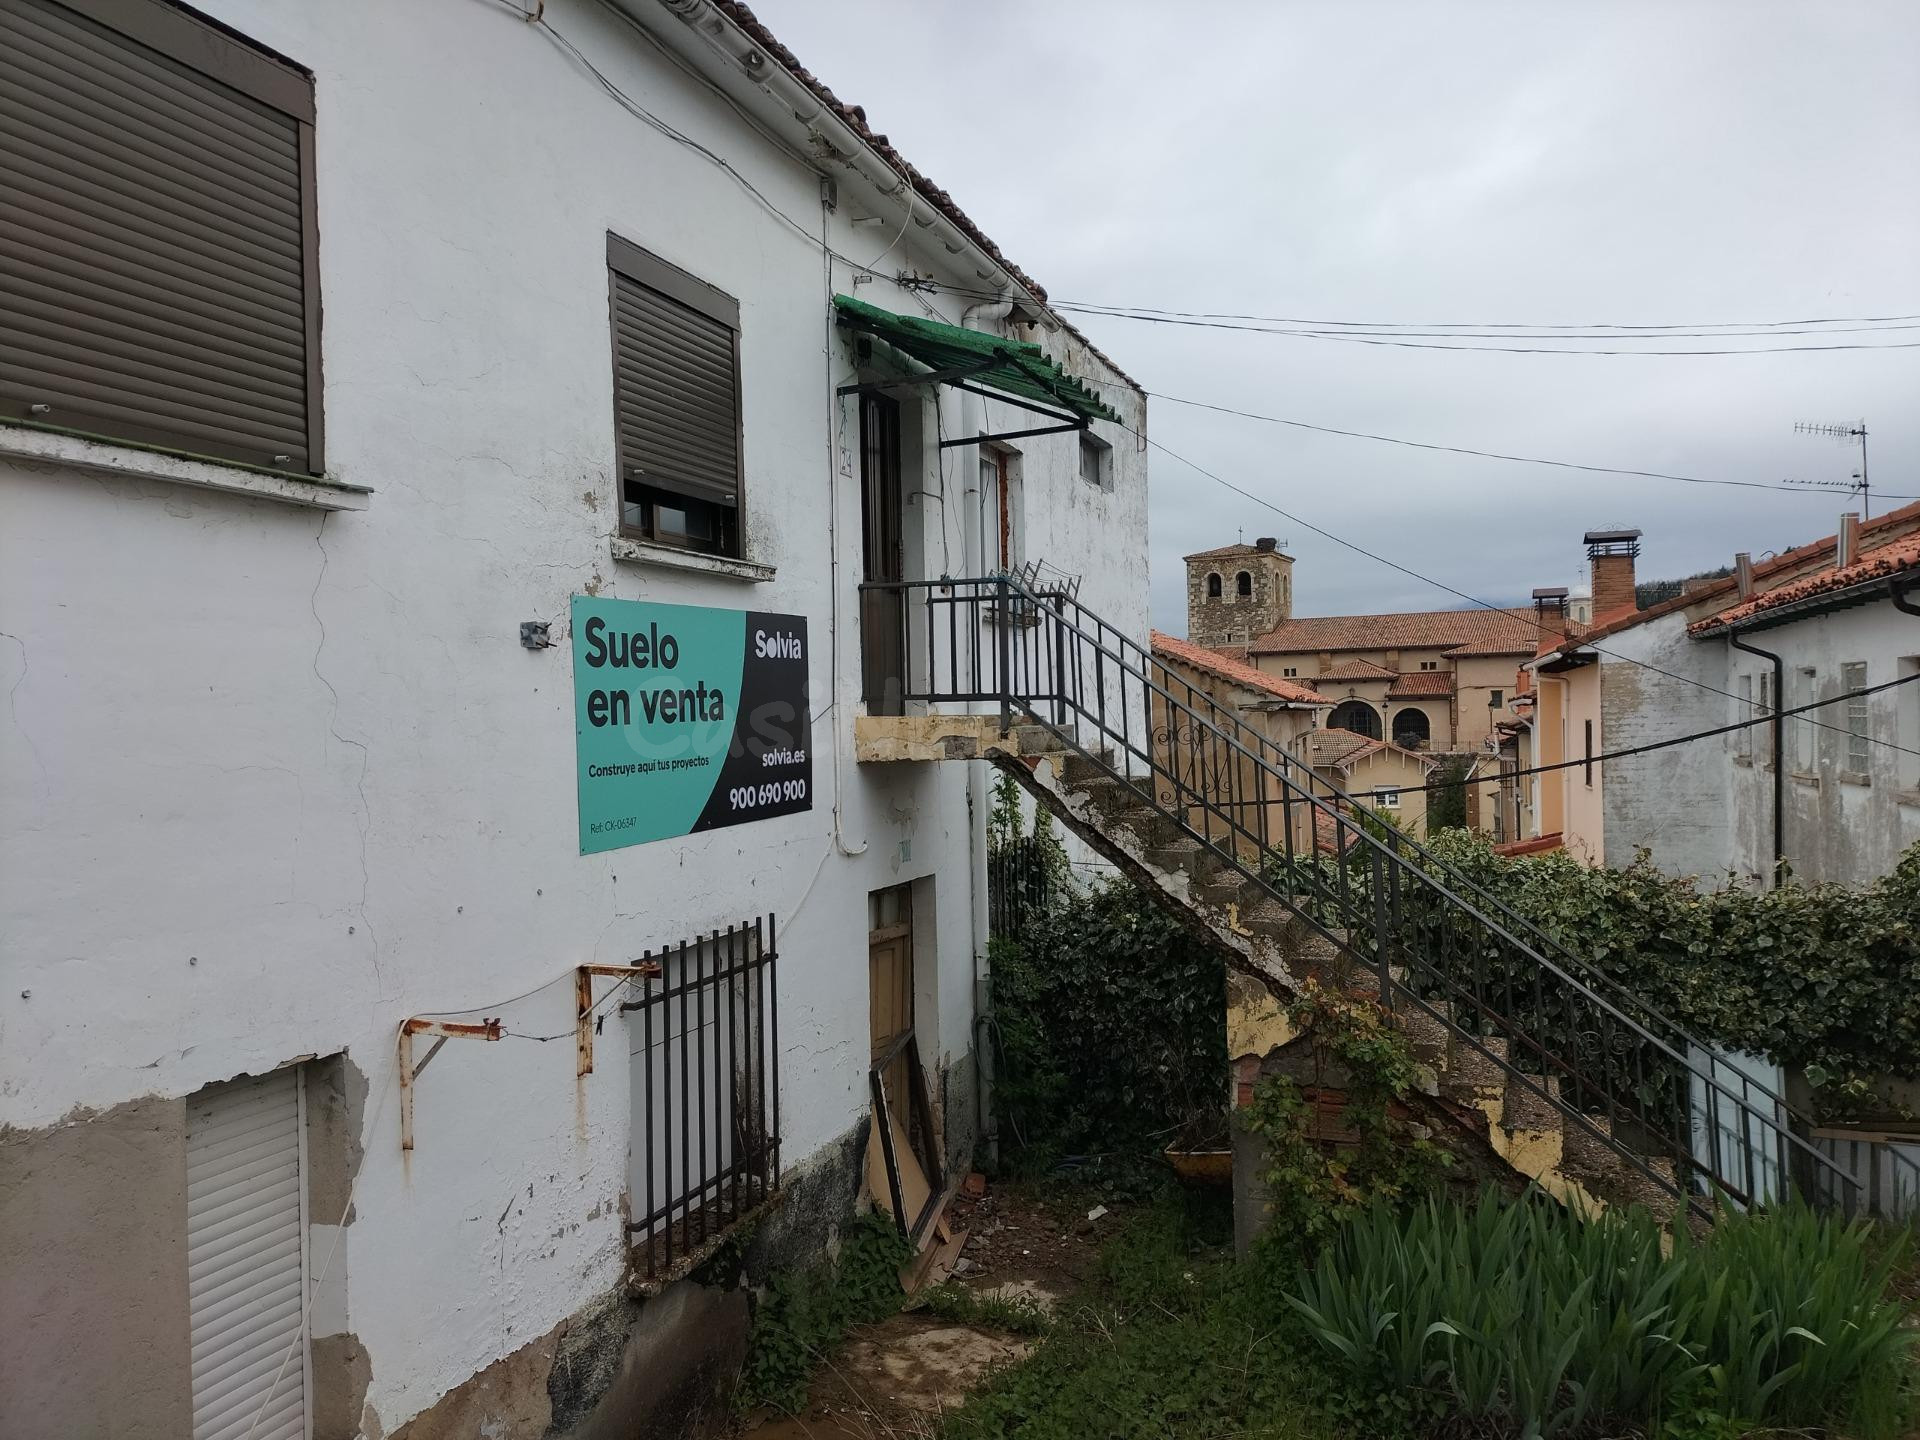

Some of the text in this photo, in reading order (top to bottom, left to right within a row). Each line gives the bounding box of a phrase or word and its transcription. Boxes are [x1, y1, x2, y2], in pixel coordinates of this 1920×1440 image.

[585, 616, 679, 669] Suelo
[755, 629, 802, 659] Solvia
[587, 689, 631, 727] en
[640, 681, 724, 724] venta
[588, 756, 709, 777] Construye aquí tus proyectos
[762, 747, 805, 767] solvia.es
[730, 779, 806, 810] 900 690 900
